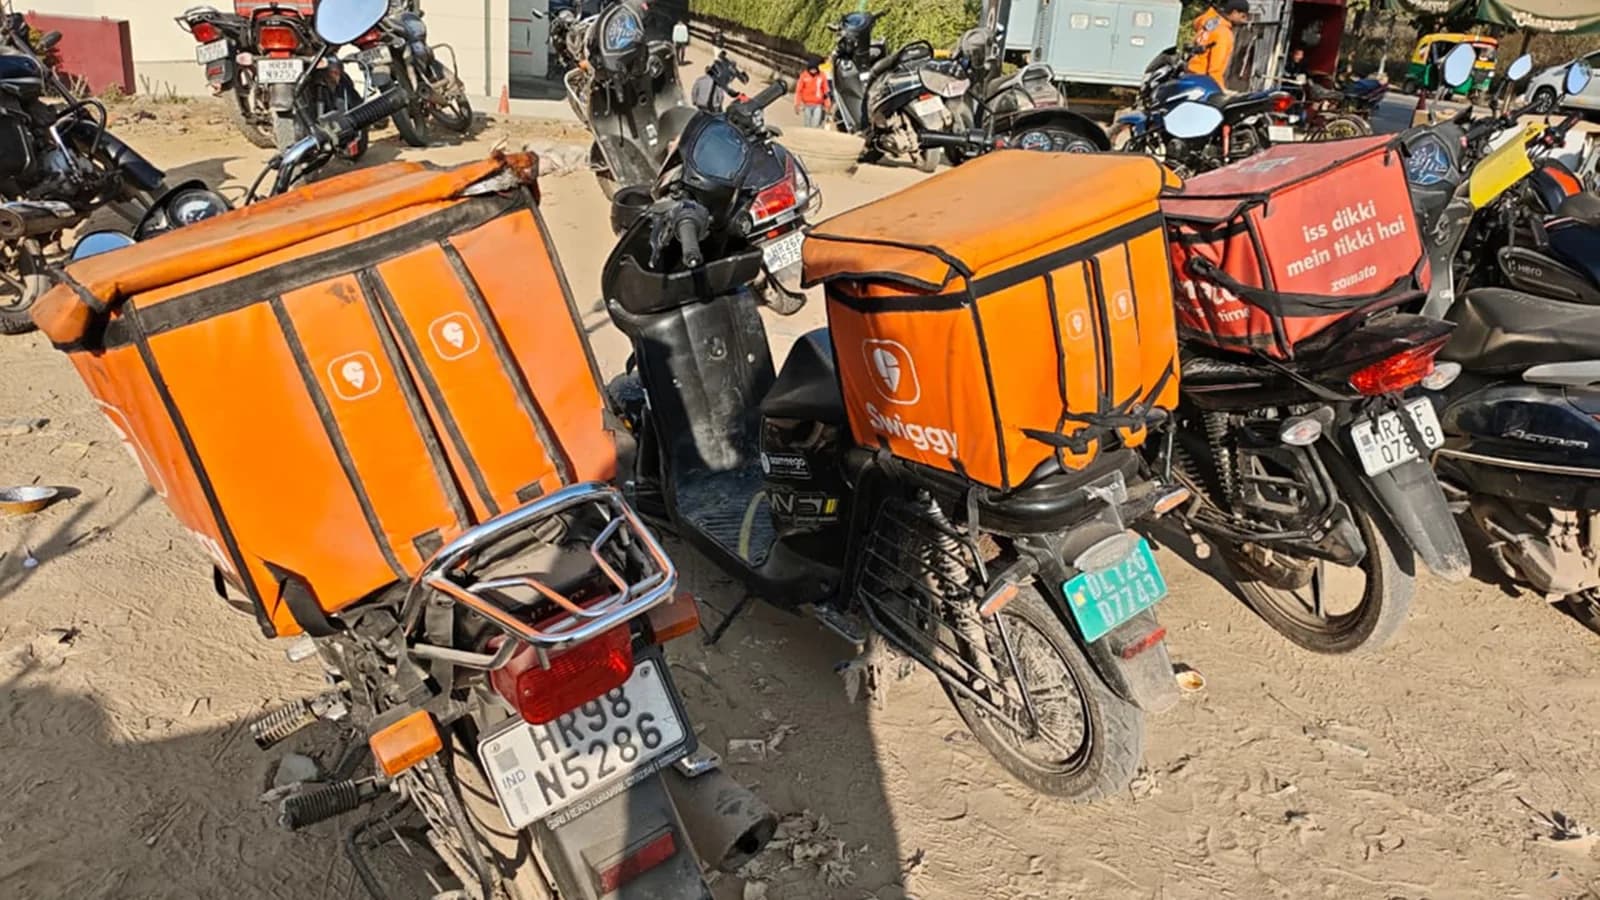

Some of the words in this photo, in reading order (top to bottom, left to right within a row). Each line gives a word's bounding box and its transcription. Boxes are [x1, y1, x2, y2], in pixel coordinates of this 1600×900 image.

[1286, 248, 1331, 277] mein
[1333, 227, 1375, 257] tikki
[1376, 214, 1406, 240] hai
[1302, 225, 1328, 243] iss
[1332, 199, 1377, 232] dikki
[1331, 265, 1377, 292] zomato
[866, 402, 958, 459] Swiggy
[528, 685, 632, 761] HR98
[502, 769, 527, 790] IND
[534, 712, 662, 806] N5286
